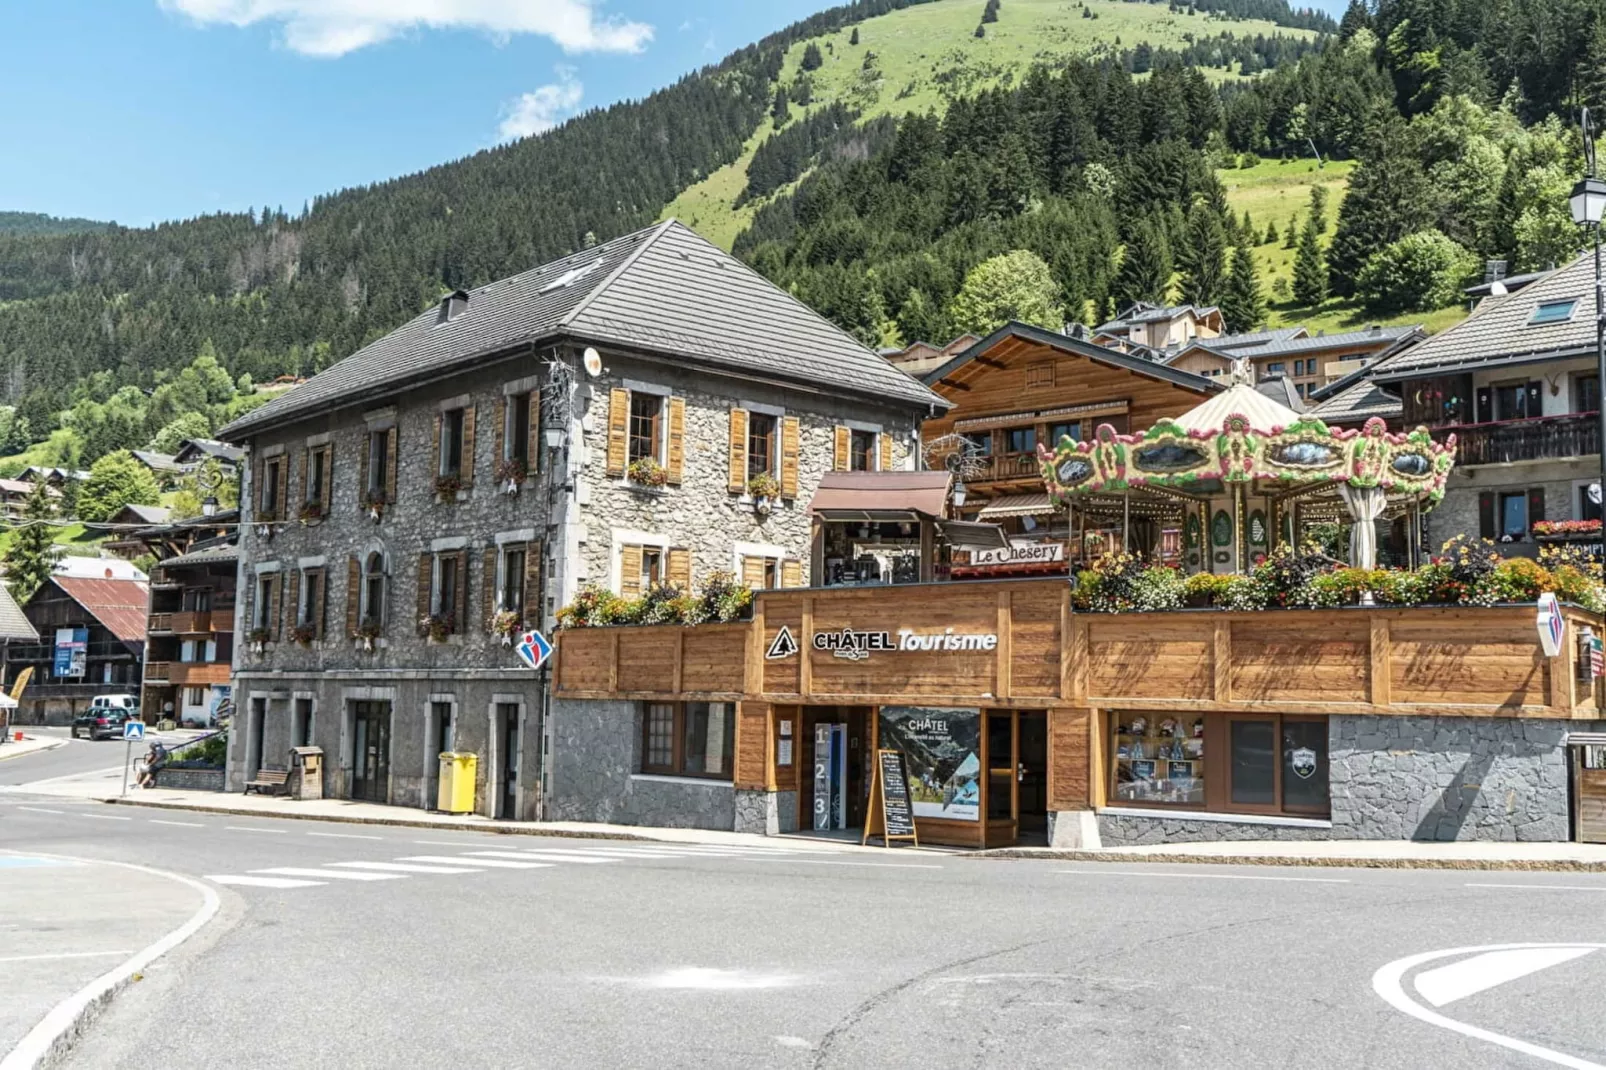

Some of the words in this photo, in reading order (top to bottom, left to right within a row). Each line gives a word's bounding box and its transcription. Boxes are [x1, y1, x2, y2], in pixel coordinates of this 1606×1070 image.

[976, 550, 994, 563] Le
[996, 545, 1059, 563] Chesery
[814, 628, 896, 650] CHÂTEL
[898, 627, 998, 651] Tourisme
[908, 715, 949, 731] CHÂTEL
[815, 764, 826, 779] 2
[815, 799, 825, 814] 3
